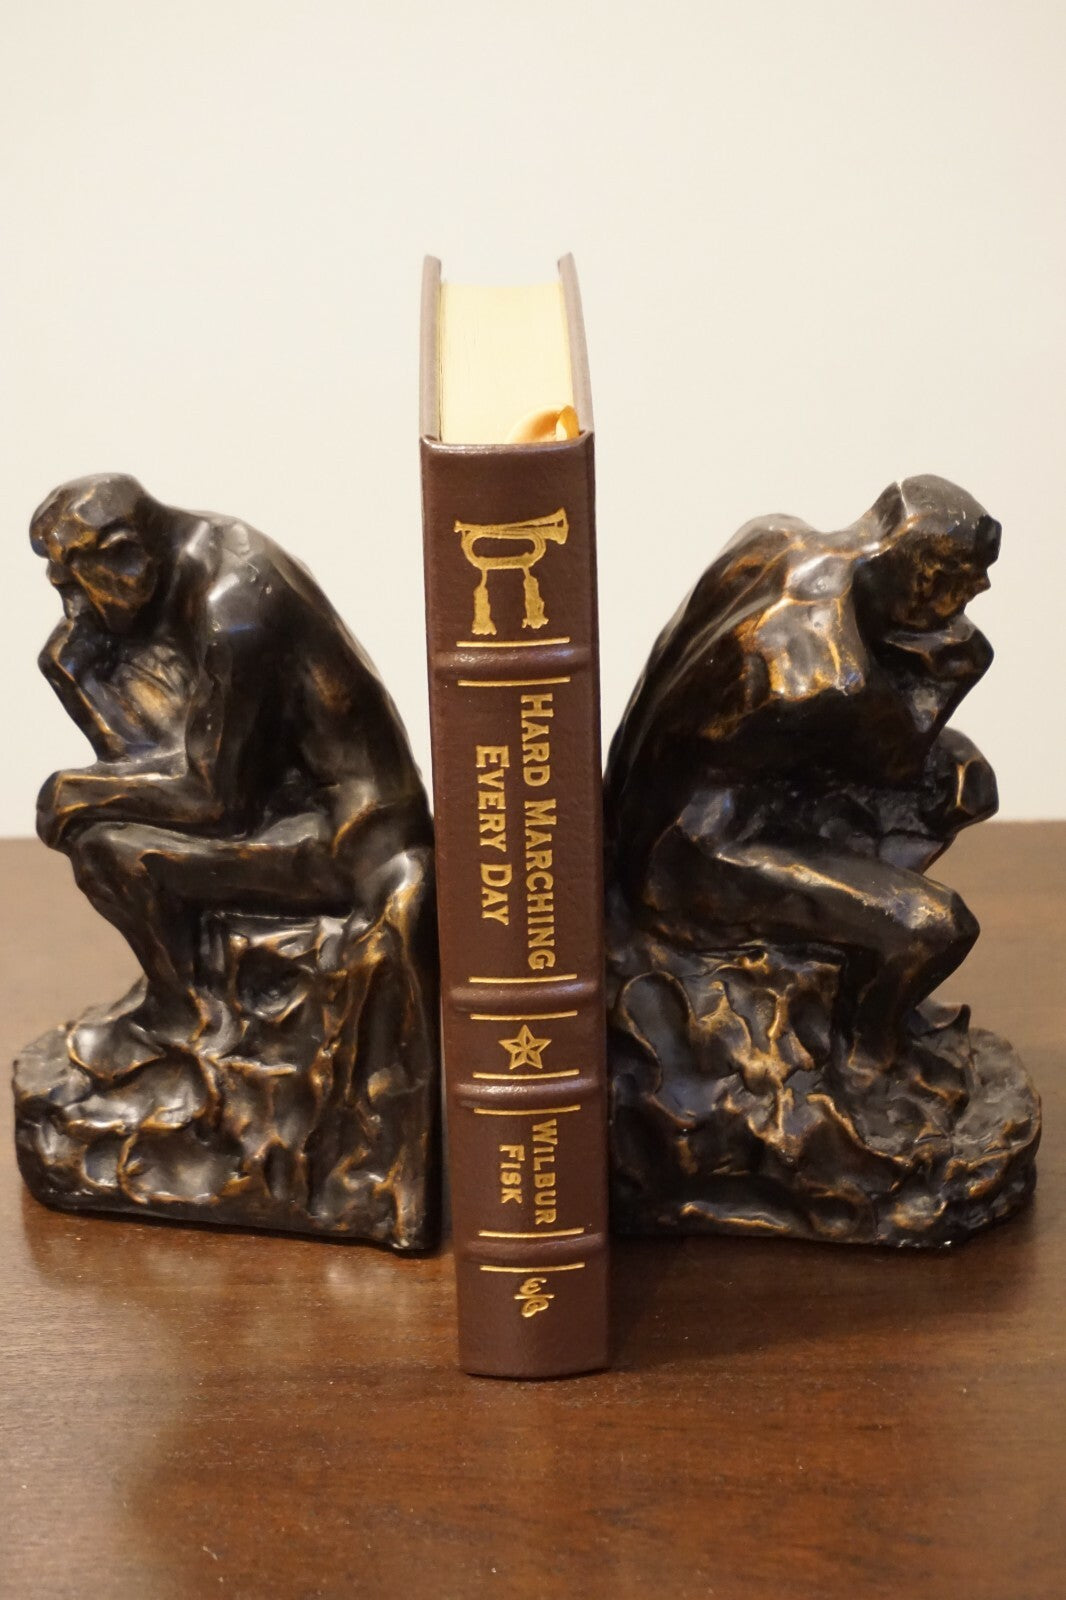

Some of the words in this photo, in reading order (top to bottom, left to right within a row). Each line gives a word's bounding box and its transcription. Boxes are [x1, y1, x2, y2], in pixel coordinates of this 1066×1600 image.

[521, 693, 554, 787] HARD
[476, 745, 510, 852] EVERY
[480, 863, 513, 925] DAY
[524, 799, 557, 970] MARCHING
[499, 1144, 526, 1204] FISK
[532, 1118, 558, 1226] WILBUR
